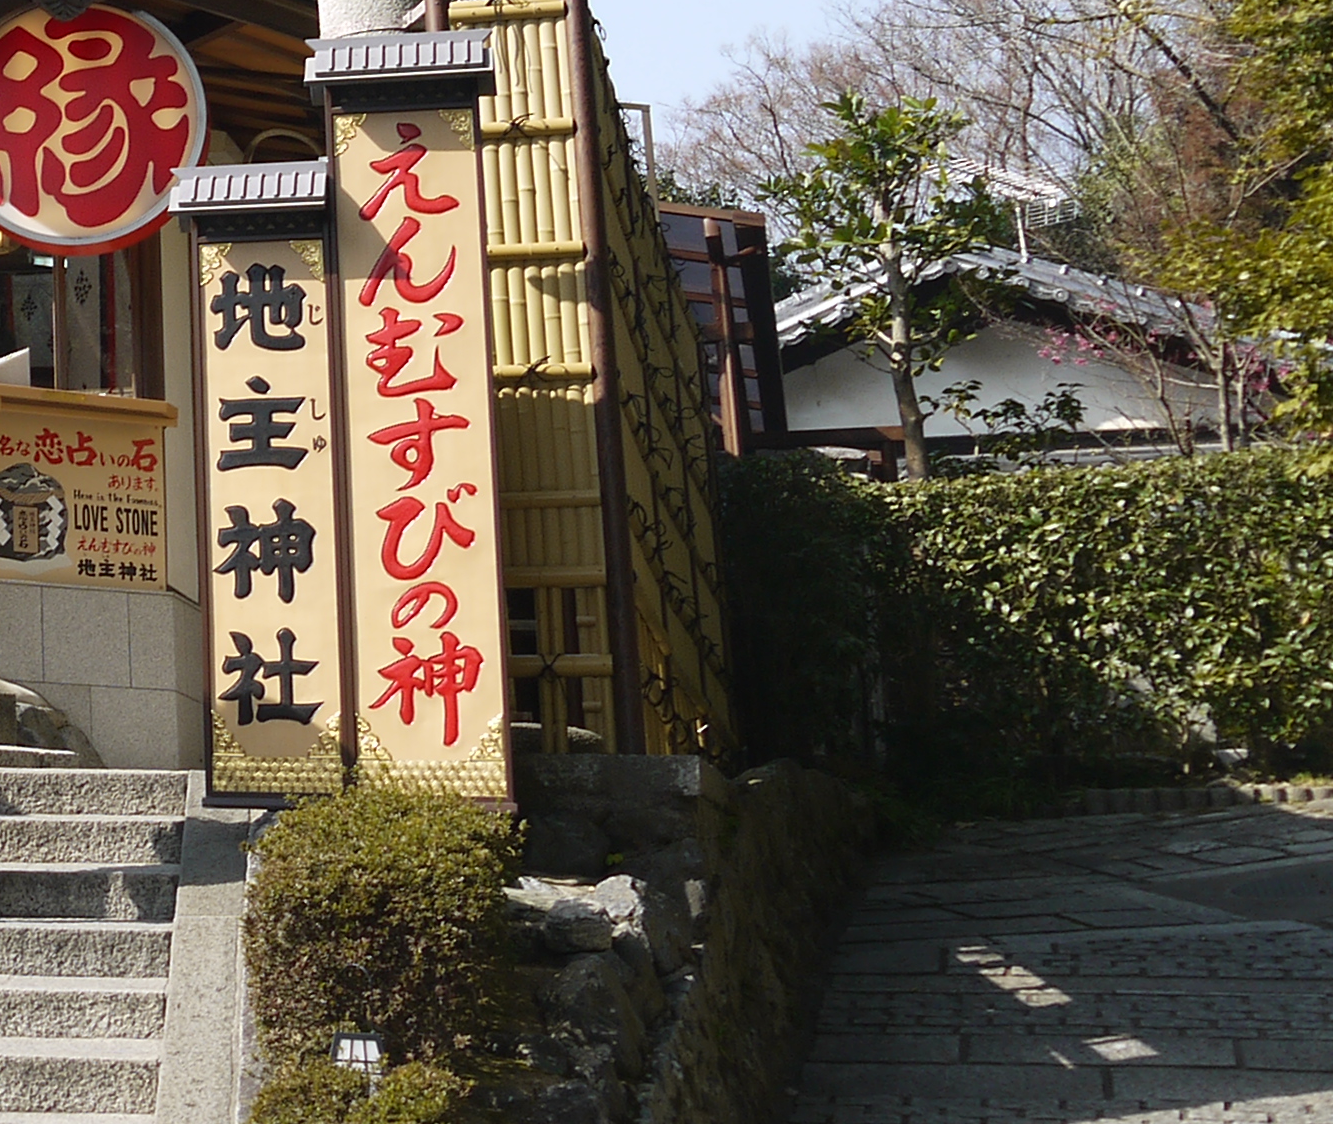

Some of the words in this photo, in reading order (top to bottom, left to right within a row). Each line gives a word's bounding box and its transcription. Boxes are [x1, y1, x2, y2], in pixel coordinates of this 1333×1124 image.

[74, 503, 109, 533] LOVE
[115, 506, 159, 536] STONE
[212, 263, 325, 726] 地主神社
[358, 122, 485, 748] えんむすびの神
[77, 558, 158, 582] 地主神社
